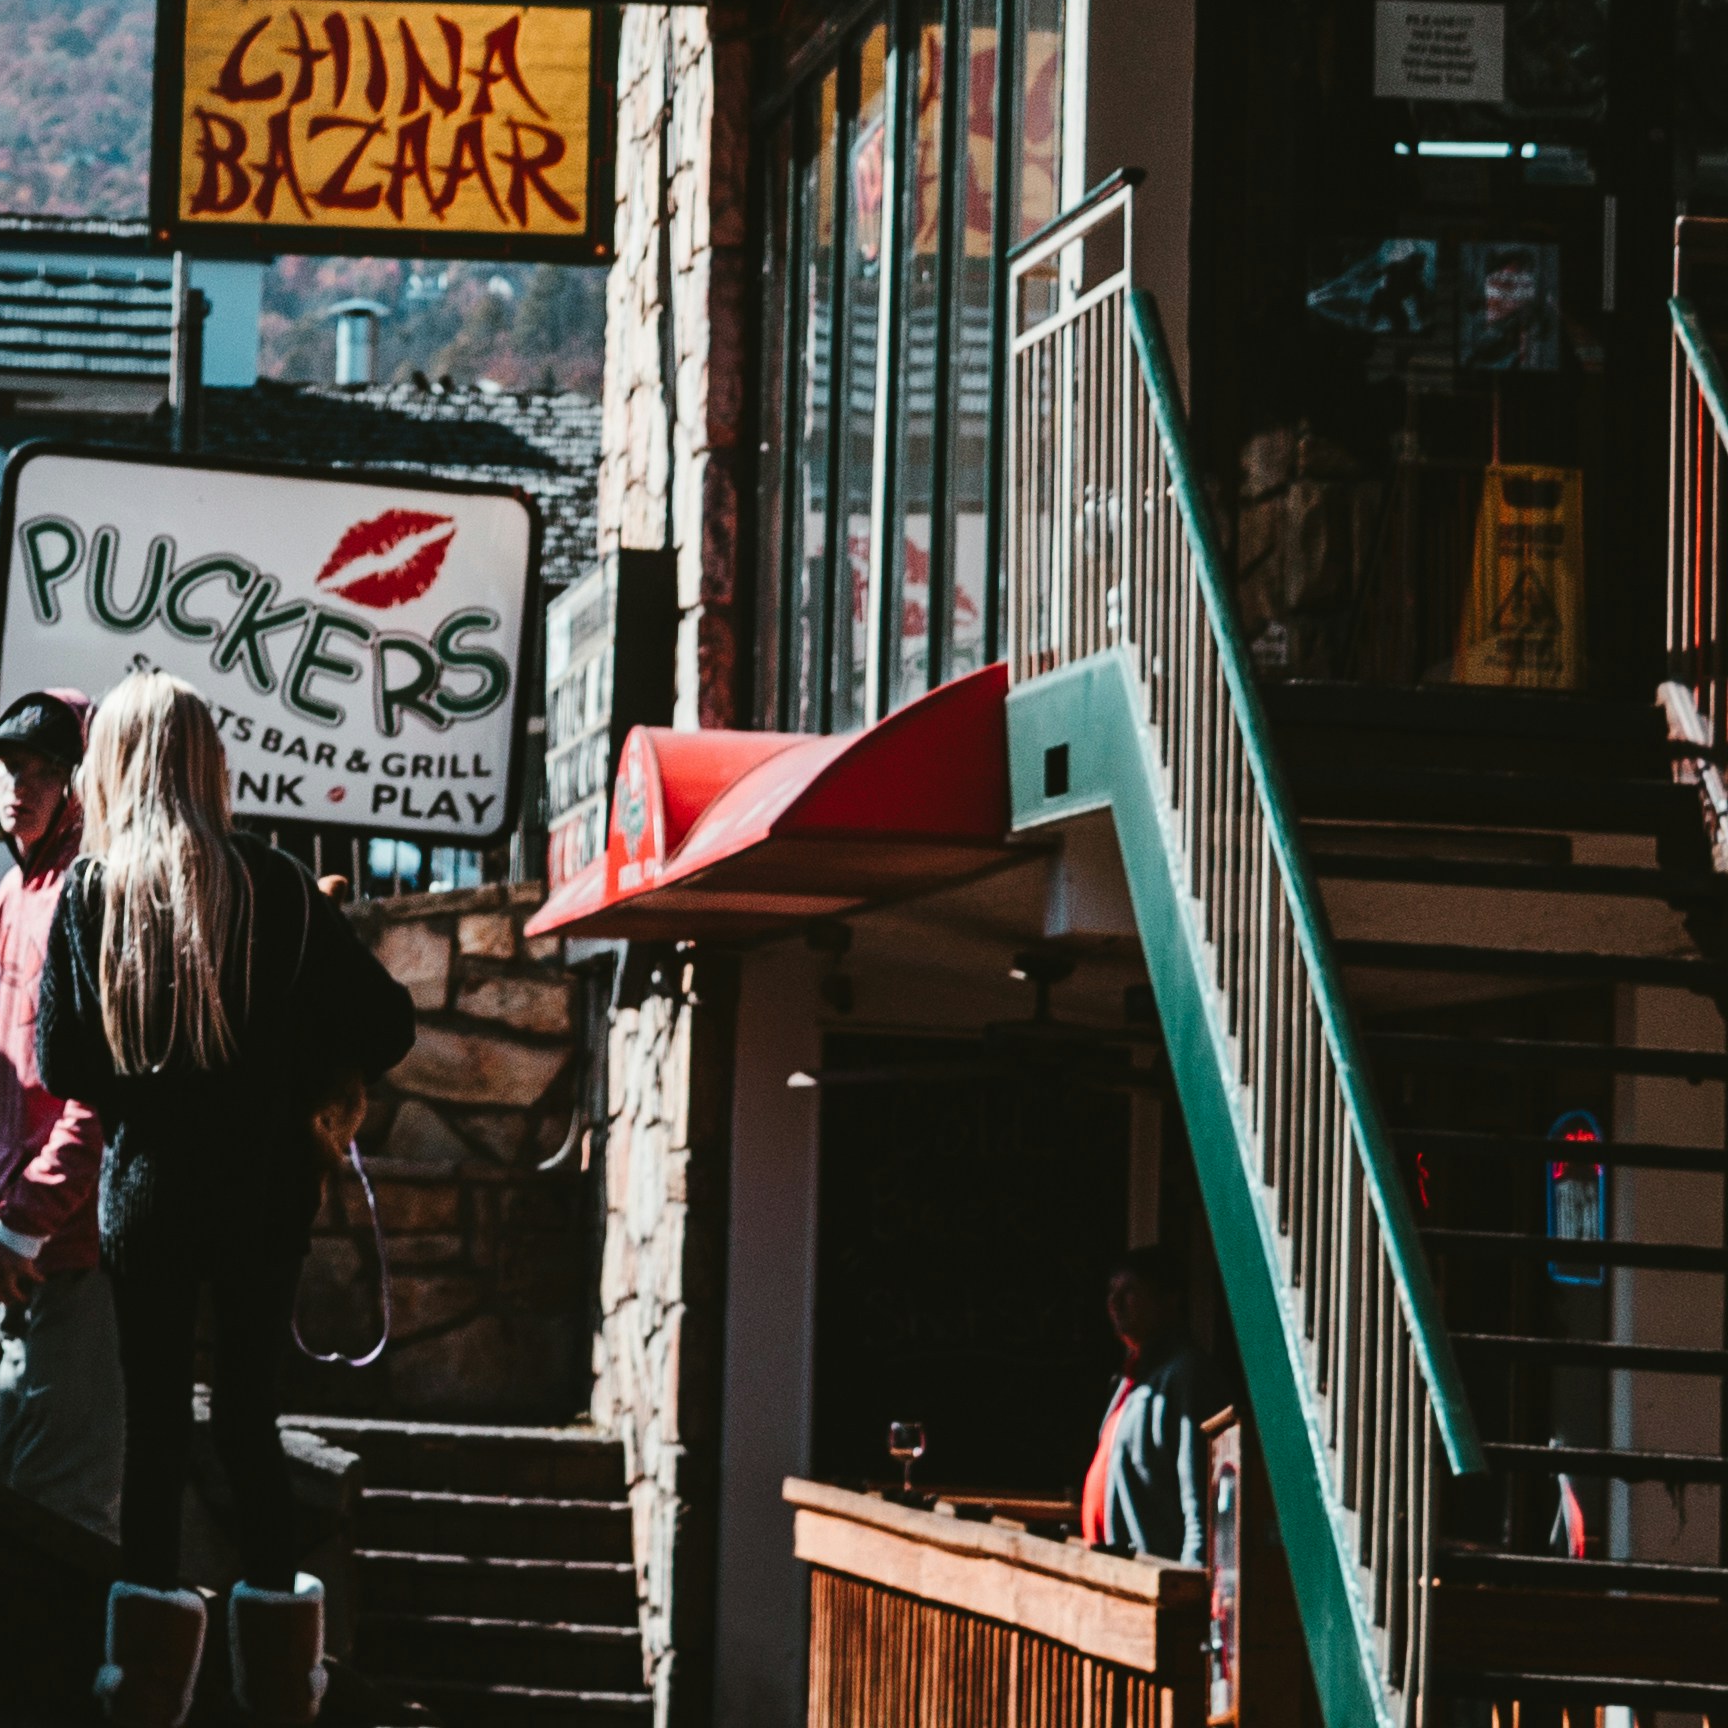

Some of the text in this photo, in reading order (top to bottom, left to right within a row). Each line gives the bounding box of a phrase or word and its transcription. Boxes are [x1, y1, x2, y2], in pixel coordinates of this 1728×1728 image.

[211, 8, 550, 120] CHINA
[189, 102, 582, 227] BAZAAR
[19, 514, 510, 738] PUCKERS
[236, 771, 496, 825] NK PLAY
[261, 728, 336, 769] BAR
[345, 747, 371, 774] &
[381, 750, 492, 780] GRILL
